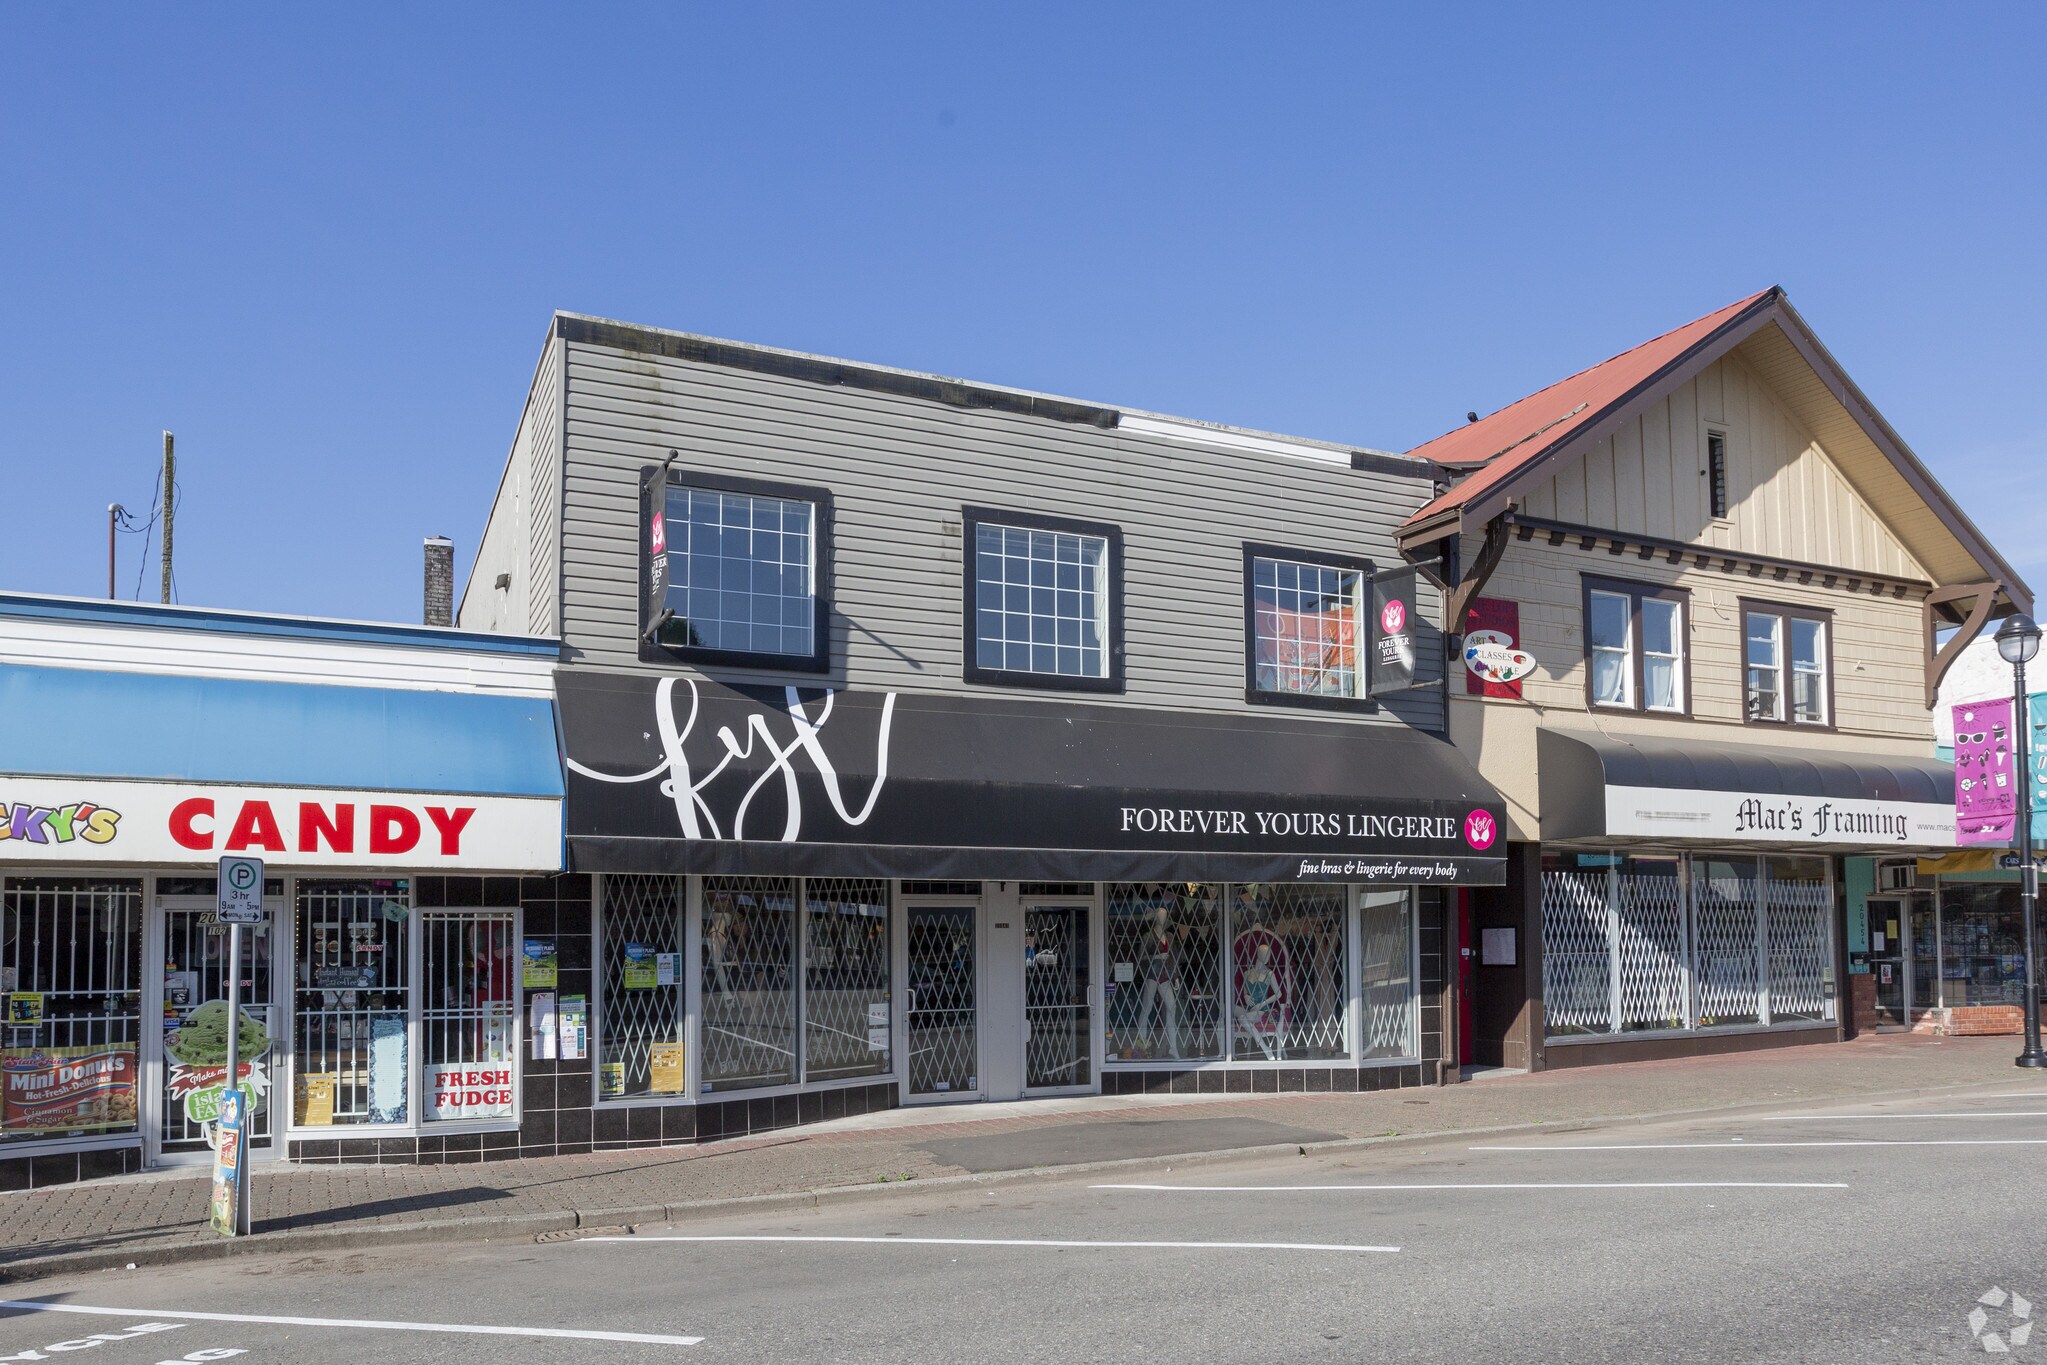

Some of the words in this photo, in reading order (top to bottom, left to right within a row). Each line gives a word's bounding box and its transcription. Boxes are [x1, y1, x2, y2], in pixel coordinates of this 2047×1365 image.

[1378, 637, 1409, 650] FOREVER
[1470, 636, 1486, 644] ART
[1477, 650, 1512, 661] CLASSES
[168, 797, 477, 856] CANDY
[1120, 807, 1250, 834] FOREVER
[1255, 812, 1341, 836] YOURS
[1347, 814, 1457, 839] LINGERIE
[1735, 798, 1802, 832] Mac's
[1811, 802, 1908, 841] Framing
[1297, 859, 1319, 878] fine
[1321, 860, 1342, 874] bras
[1344, 861, 1355, 874] &
[1356, 861, 1393, 879] lingerie
[1392, 861, 1408, 878] for
[1409, 866, 1434, 880] every
[1435, 862, 1457, 880] body
[231, 890, 238, 900] 3
[240, 891, 250, 900] hr
[222, 901, 235, 909] 9AM
[246, 902, 259, 910] 5PM
[200, 913, 216, 924] 20
[208, 927, 226, 935] 102
[10, 1070, 55, 1091] Mini
[59, 1056, 125, 1085] Donuts
[190, 1070, 217, 1086] Make
[435, 1070, 510, 1088] FRESH
[26, 1075, 111, 1100] Hot-Fresh-Delicious
[195, 1083, 246, 1108] isla
[435, 1089, 512, 1108] FUDGE
[24, 1106, 73, 1116] Cinnamon
[26, 1115, 33, 1124] &
[36, 1115, 61, 1124] Sugar
